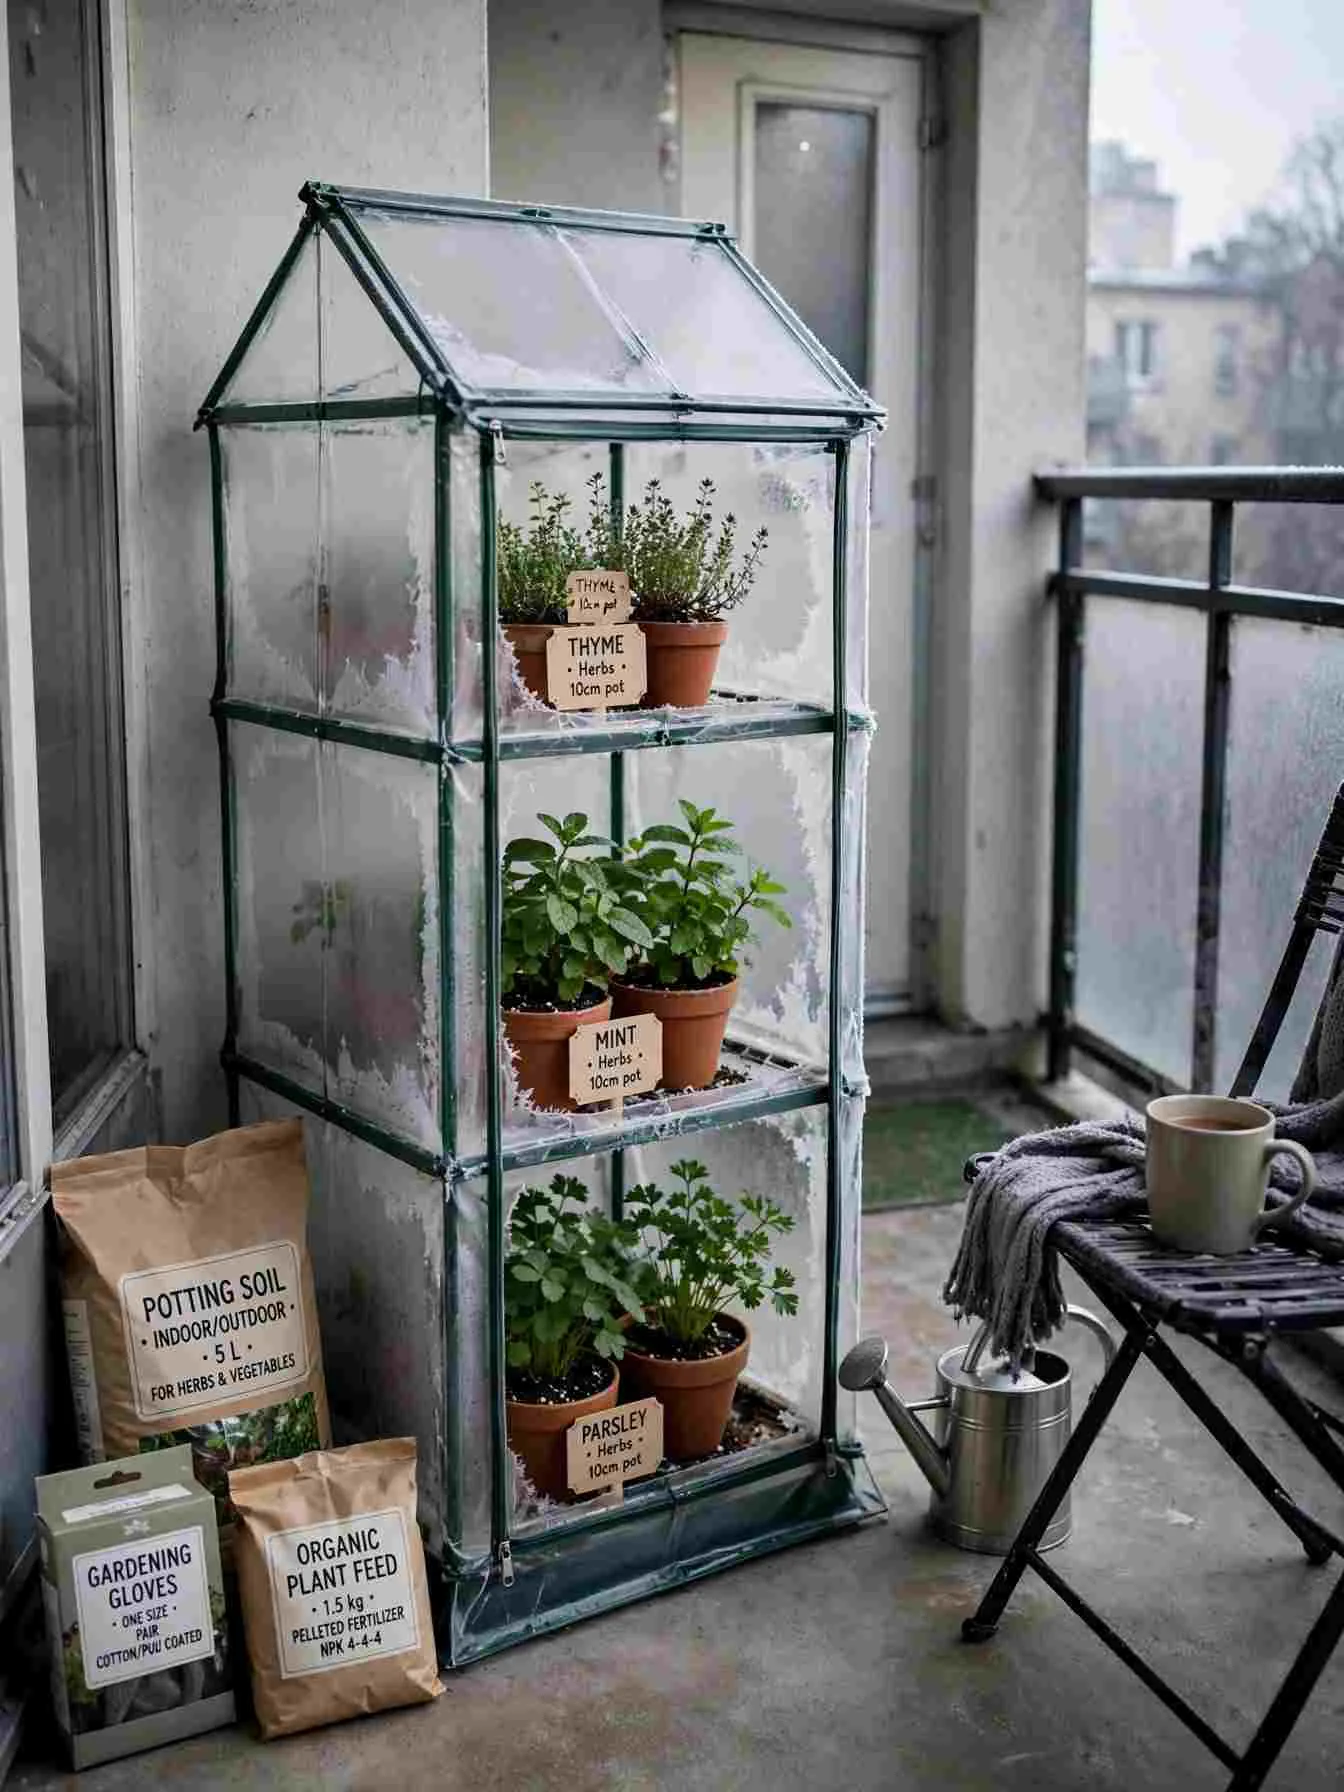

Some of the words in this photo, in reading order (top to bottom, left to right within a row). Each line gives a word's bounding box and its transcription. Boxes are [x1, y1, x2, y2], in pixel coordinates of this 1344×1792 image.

[568, 634, 624, 657] THYME
[579, 660, 615, 676] Herbs
[570, 682, 601, 697] 10cm
[605, 680, 625, 698] pot
[596, 1025, 636, 1051] MINT
[599, 1050, 632, 1069] Herbs
[590, 1075, 619, 1090] 10cm
[623, 1069, 642, 1087] pot
[143, 1279, 235, 1323] POTTING
[240, 1267, 287, 1300] SOIL
[153, 1301, 287, 1349] INDOOR/OUTDOOR
[215, 1344, 225, 1364] 5
[231, 1340, 241, 1361] L
[151, 1383, 175, 1401] FOR
[177, 1374, 216, 1397] HERBS
[217, 1372, 227, 1386] &
[229, 1353, 296, 1383] VEGETABLES
[582, 1408, 647, 1444] PARSLEY
[598, 1438, 633, 1457] Herbs
[589, 1462, 619, 1479] 10cm
[623, 1454, 642, 1473] pot
[297, 1528, 380, 1565] ORGANIC
[87, 1543, 192, 1588] GARDENING
[286, 1563, 347, 1599] PLANT
[353, 1553, 398, 1583] FEED
[108, 1574, 178, 1609] GLOVES
[122, 1610, 144, 1628] ONE
[146, 1604, 168, 1624] SIZE
[323, 1596, 343, 1616] 1.5
[348, 1594, 364, 1612] kg
[136, 1623, 160, 1641] PAIR
[292, 1620, 344, 1644] PELLETED
[347, 1605, 405, 1631] FERTILIZER
[164, 1628, 202, 1651] COATED
[320, 1639, 344, 1659] NPK
[347, 1631, 382, 1651] 4-4-4
